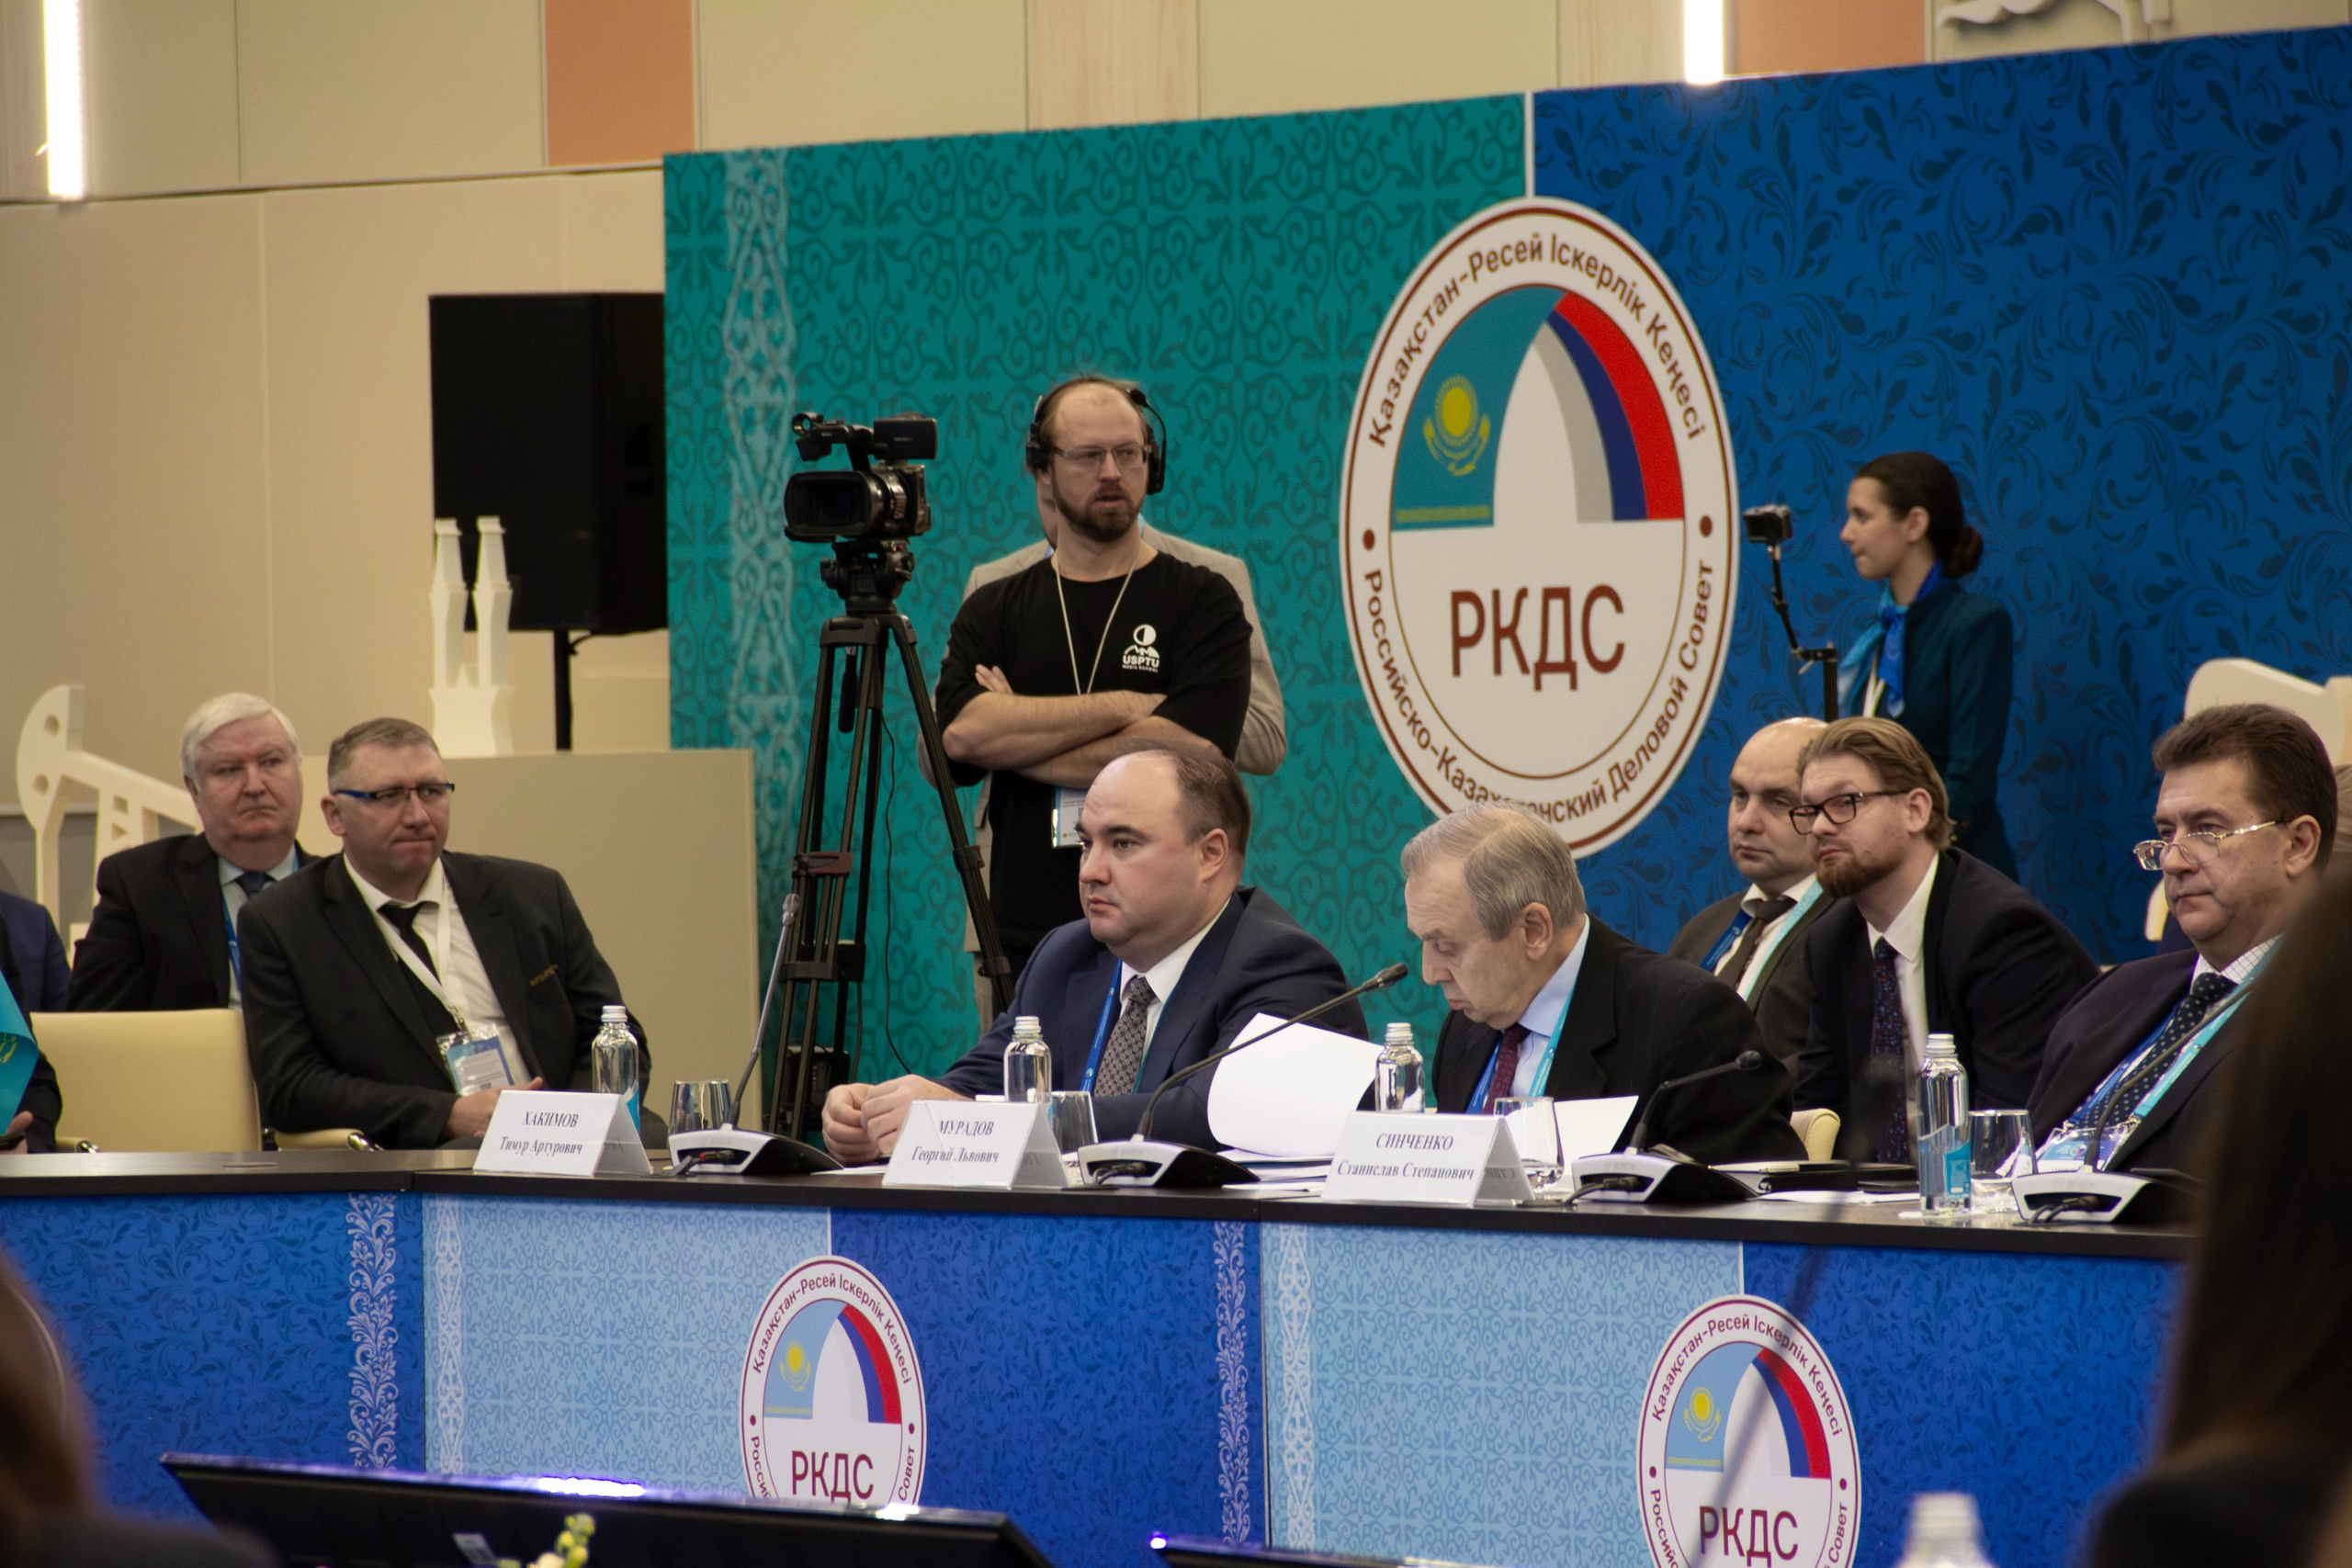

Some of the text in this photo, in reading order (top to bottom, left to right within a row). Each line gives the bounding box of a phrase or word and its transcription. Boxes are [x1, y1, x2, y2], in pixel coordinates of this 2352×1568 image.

[1369, 233, 1706, 448] Қазақстан-Ресей Іскерлік Кеңесі
[1122, 654, 1160, 668] USPTU
[1450, 584, 1625, 692] РКДС
[1608, 675, 1690, 802] Деловой
[1678, 559, 1713, 671] Совет
[499, 1135, 583, 1157] Тимур Артурович
[522, 1111, 579, 1128] ХАКИМОВ
[939, 1120, 995, 1136] МУРАДОВ
[1375, 1132, 1453, 1151] СИНЧЕНКО
[911, 1145, 1000, 1166] Георгий Львович
[1338, 1159, 1399, 1178] Станислав
[1402, 1162, 1476, 1180] Степанович
[752, 1273, 912, 1384] Қазақстан-Ресей Іскерлік Кеңесі
[1652, 1314, 1843, 1437] Қазақстан-Ресей Іскерлік Кеңесі
[791, 1450, 875, 1505] РКДС
[898, 1445, 915, 1502] Совет
[1700, 1505, 1799, 1568] РКДС
[1828, 1502, 1848, 1563] Совет
